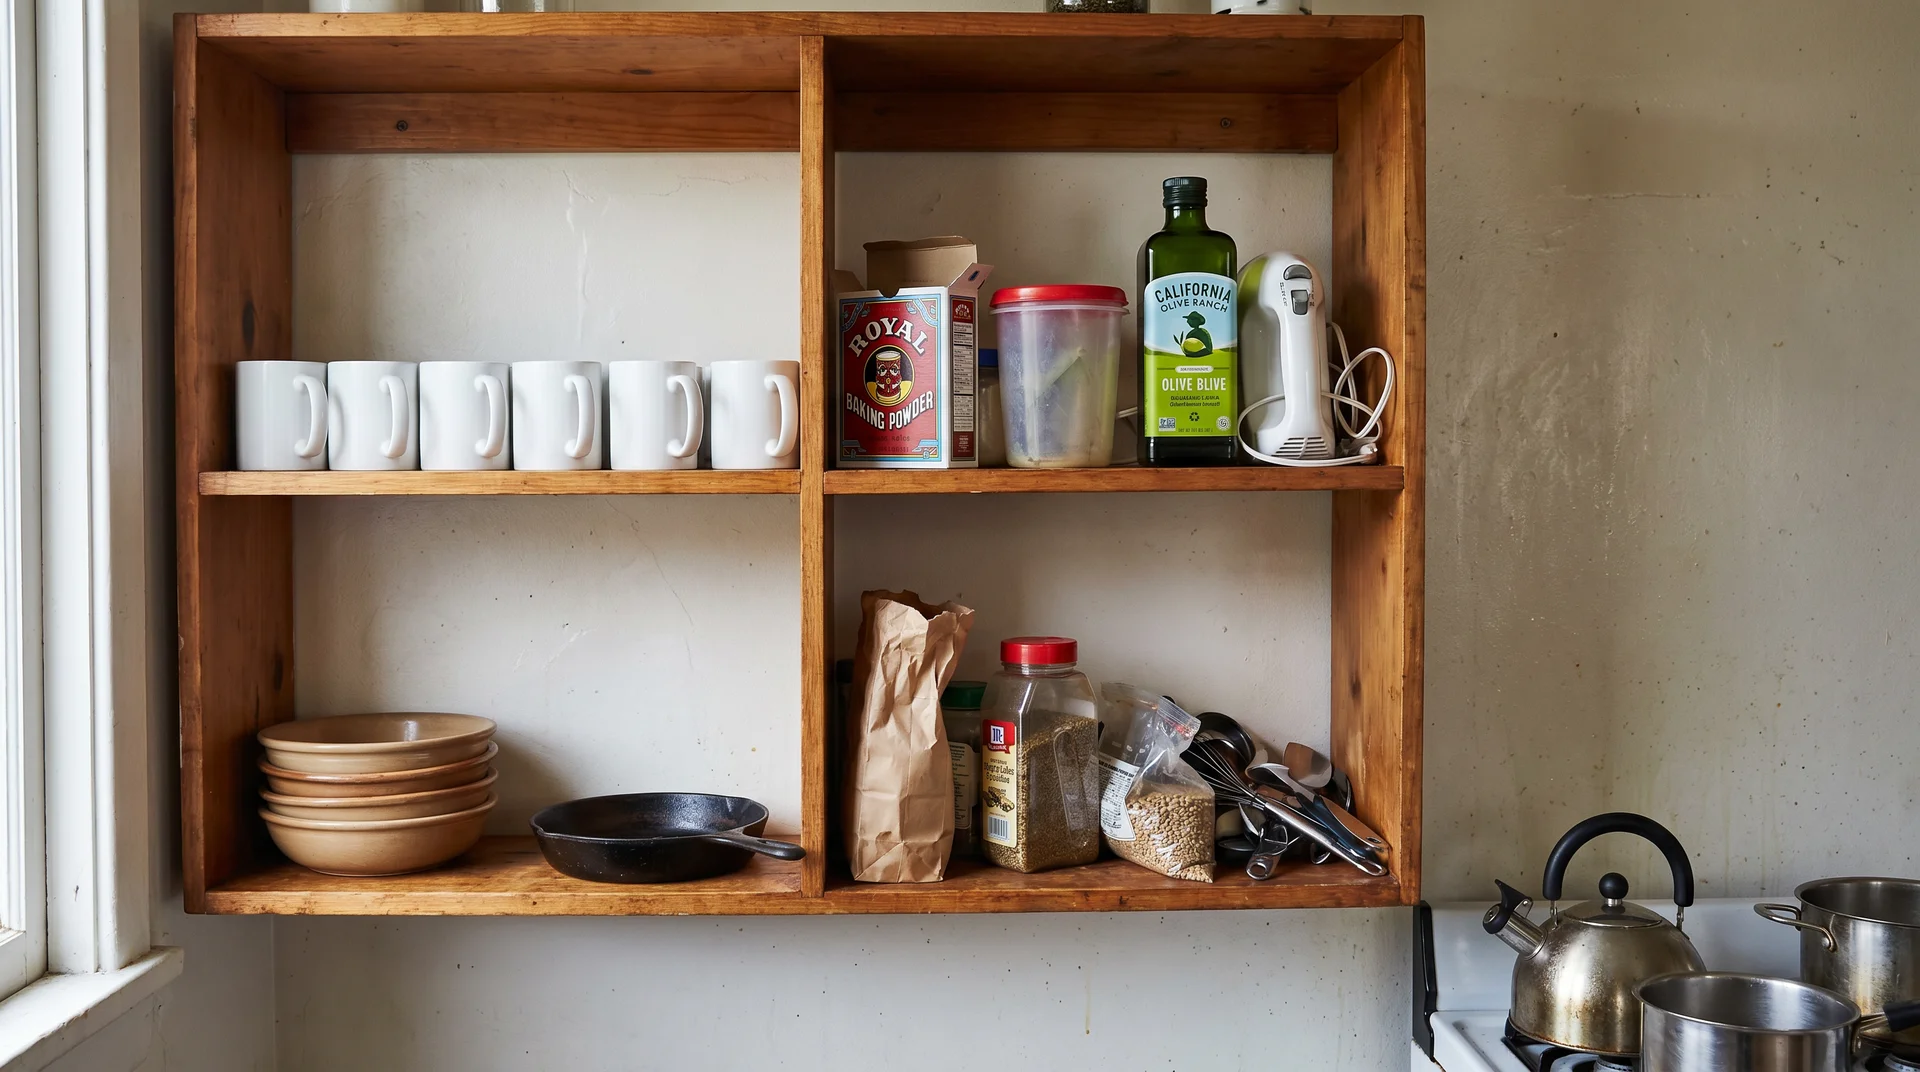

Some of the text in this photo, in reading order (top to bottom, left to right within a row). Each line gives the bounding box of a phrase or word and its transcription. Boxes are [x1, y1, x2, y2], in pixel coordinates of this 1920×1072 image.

[1154, 282, 1232, 304] CALIFORNIA
[1160, 298, 1228, 313] OLIVE RANCH
[848, 317, 928, 358] ROYAL
[1162, 377, 1227, 391] OLIVE BLIVE
[846, 390, 934, 430] BAKING POWDER
